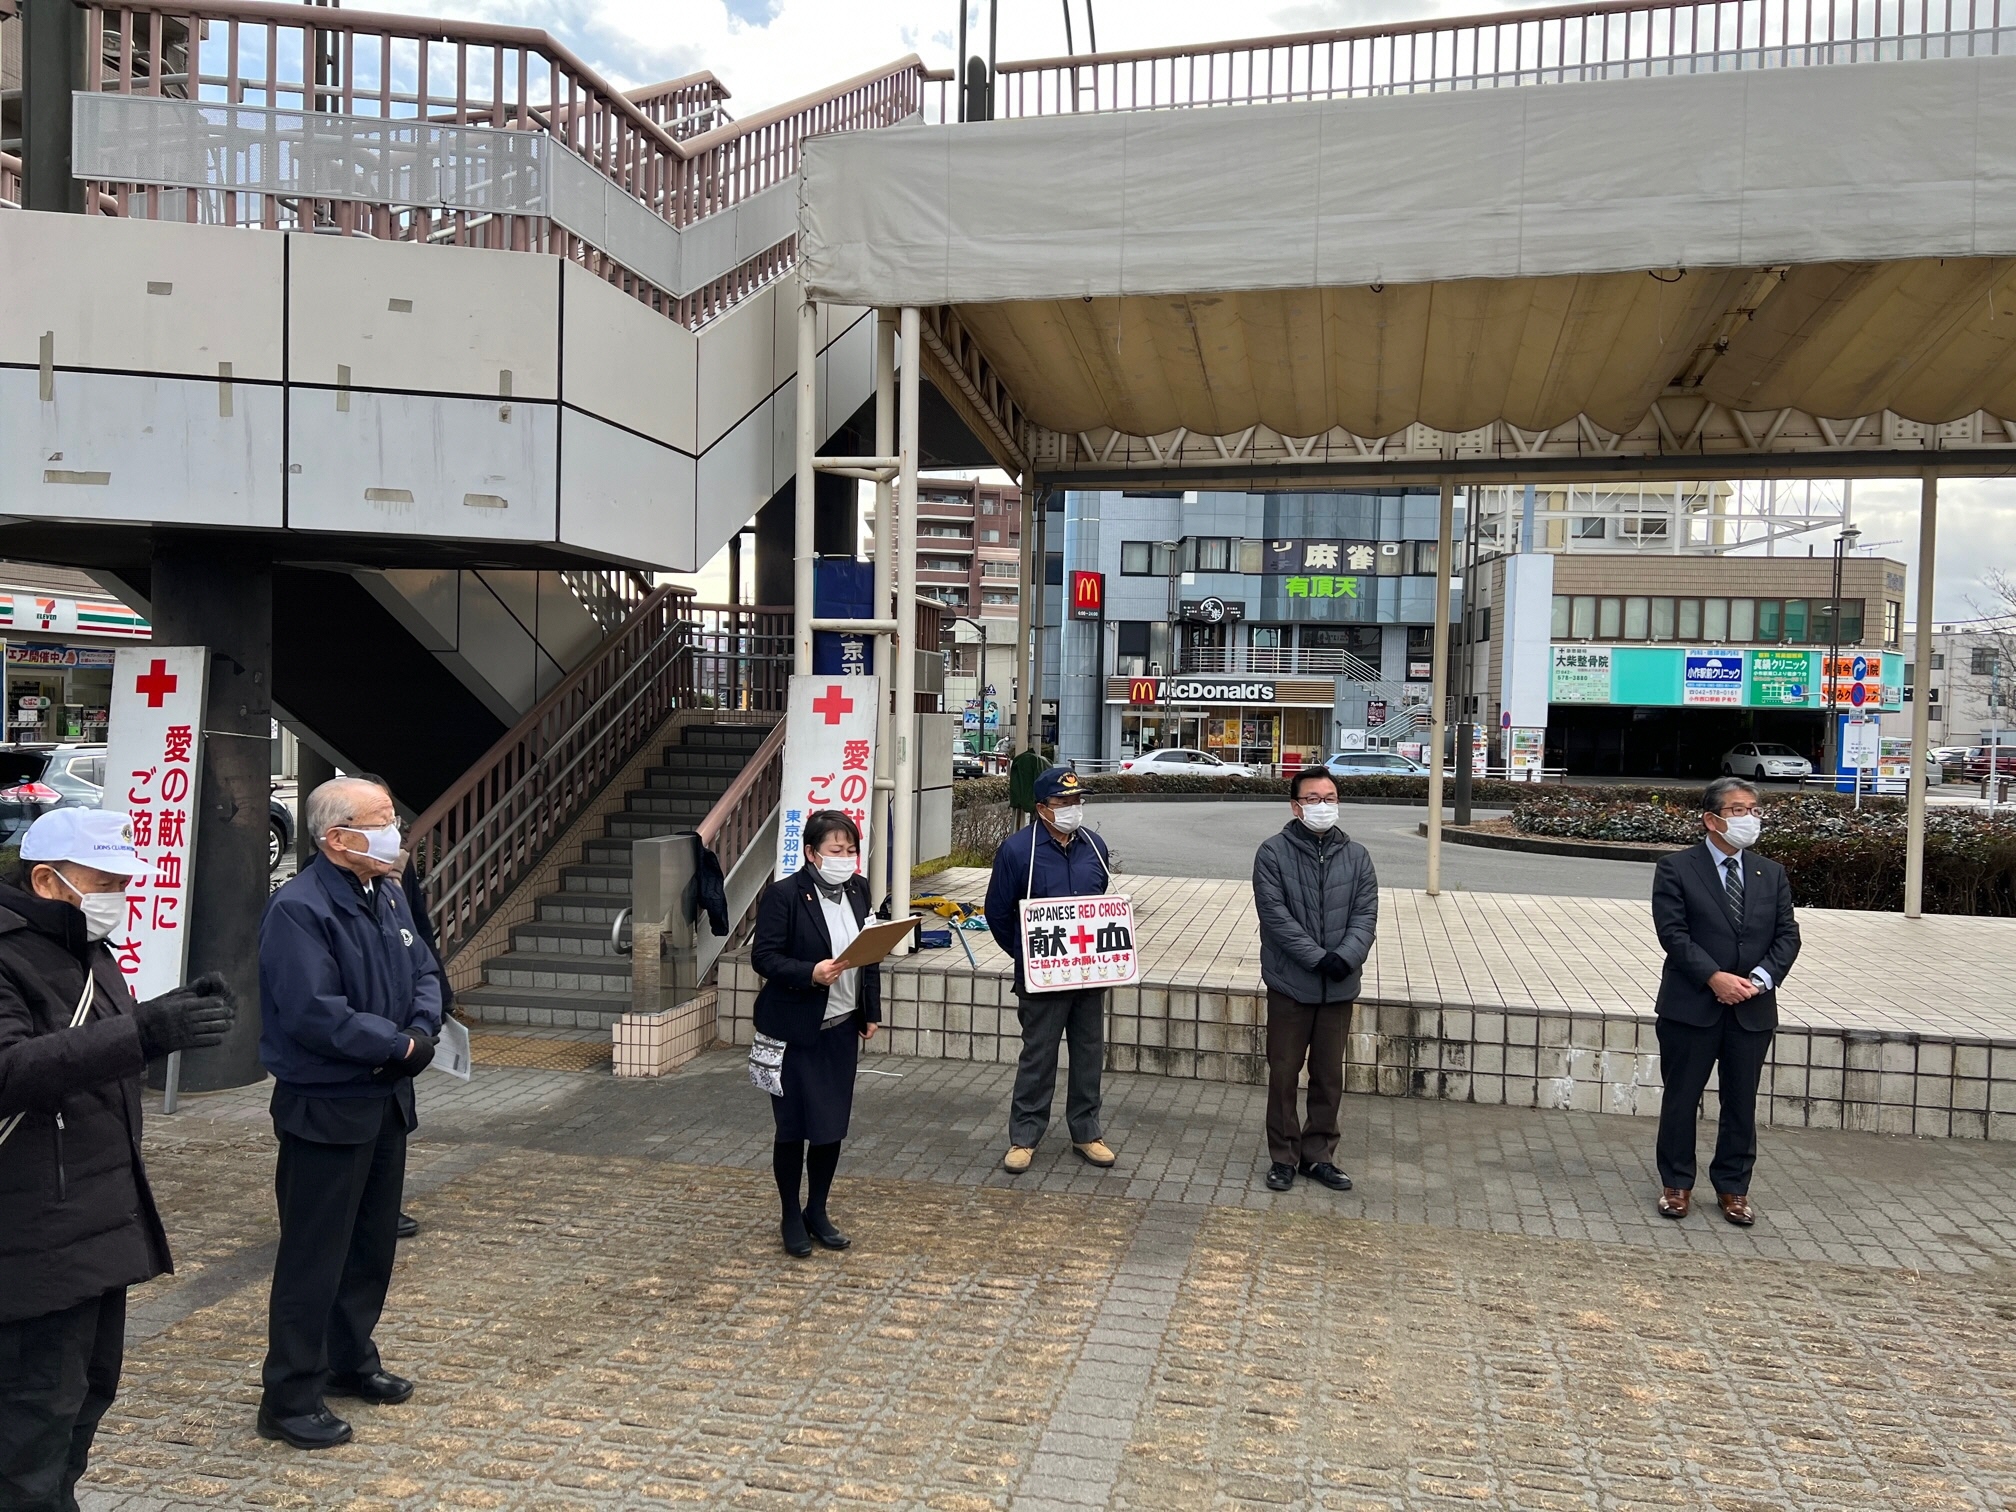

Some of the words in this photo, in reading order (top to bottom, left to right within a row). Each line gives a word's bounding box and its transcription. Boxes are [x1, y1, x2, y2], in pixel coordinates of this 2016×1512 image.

[1304, 544, 1375, 569] 麻雀
[1285, 576, 1357, 598] 有頂天
[1555, 655, 1609, 668] 大柴整骨院
[1753, 659, 1808, 670] 真鍋クリニック
[1687, 667, 1741, 679] 小作駅前クリニック
[1157, 682, 1274, 699] McDonald's
[152, 725, 192, 930] 愛の献血に
[1026, 905, 1076, 922] JAPANESE
[1078, 903, 1096, 919] RED
[1098, 902, 1127, 917] CROSS
[1030, 953, 1131, 970] ご協力をお願いします
